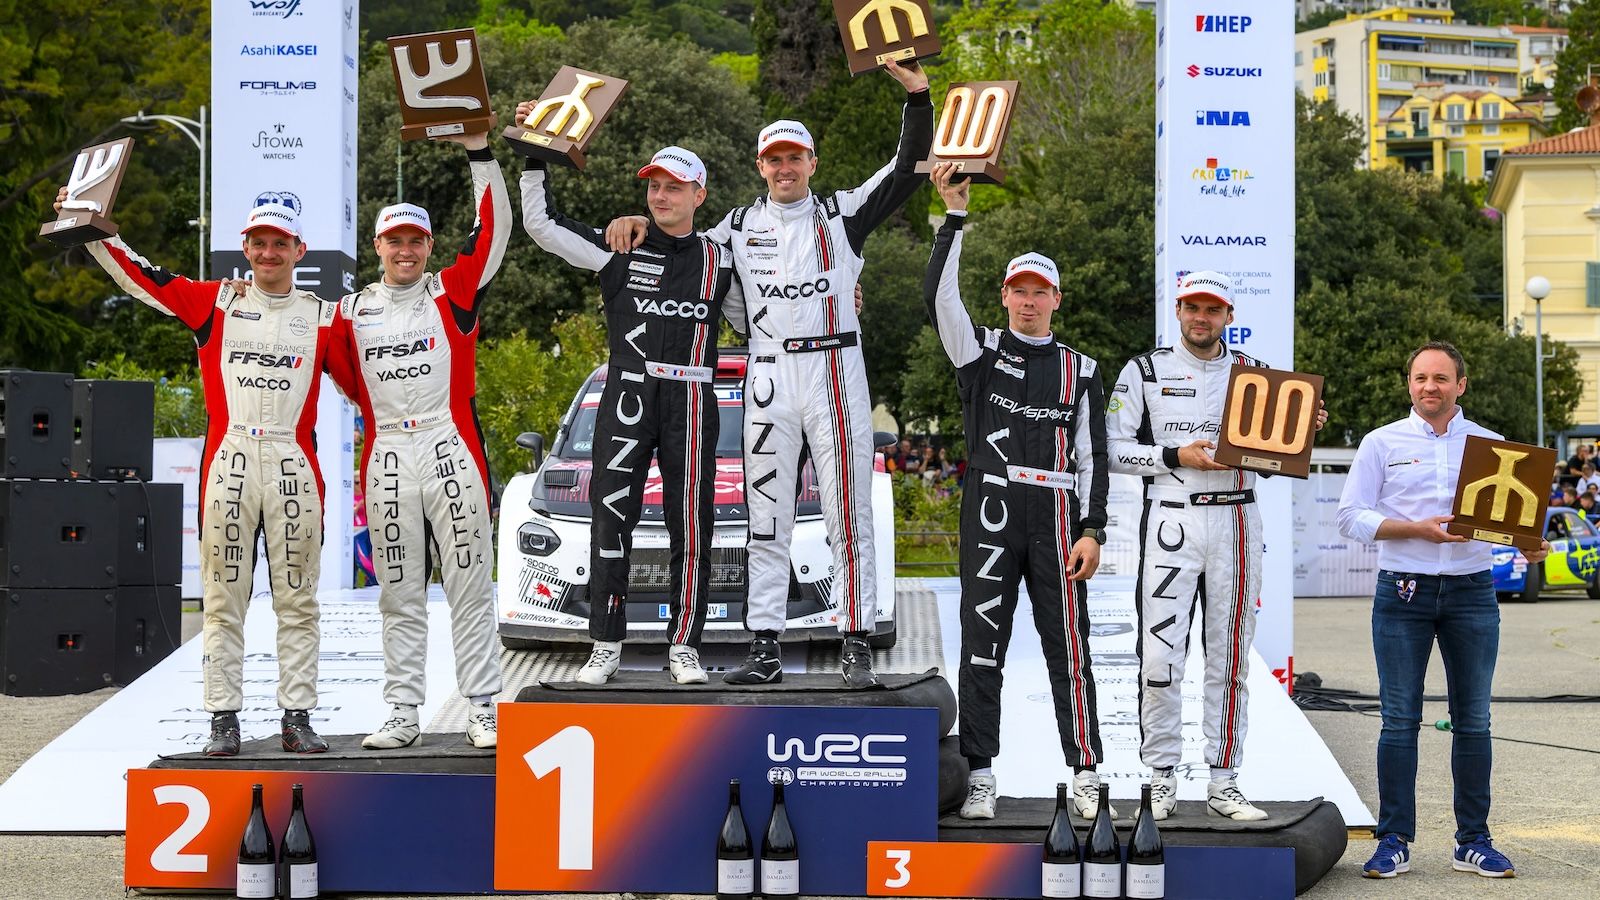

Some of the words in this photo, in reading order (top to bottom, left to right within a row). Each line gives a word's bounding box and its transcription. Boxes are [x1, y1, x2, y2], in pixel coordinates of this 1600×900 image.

[1215, 15, 1252, 33] HEP
[1204, 67, 1262, 77] SUZUKI
[240, 81, 317, 90] FORUM8
[252, 130, 304, 148] STOWA
[1192, 168, 1251, 181] CROATIA
[1200, 184, 1218, 195] Full
[1181, 235, 1267, 246] VALAMAR
[756, 277, 830, 299] YACCO
[1250, 288, 1271, 296] Sport
[633, 297, 709, 320] YACCO
[360, 335, 386, 347] EQUIPE
[388, 334, 401, 343] DE
[402, 326, 438, 340] FRANCE
[224, 339, 255, 349] EQUIPE
[257, 342, 270, 351] DE
[273, 344, 308, 355] FRANCE
[364, 339, 429, 362] FFSA
[228, 350, 293, 369] FFSA
[376, 364, 432, 383] YACCO
[236, 376, 291, 392] YACCO
[1118, 454, 1154, 467] YACCO
[767, 733, 908, 763] WRC
[523, 725, 595, 871] 1
[150, 784, 211, 873] 2
[883, 849, 911, 888] 3
